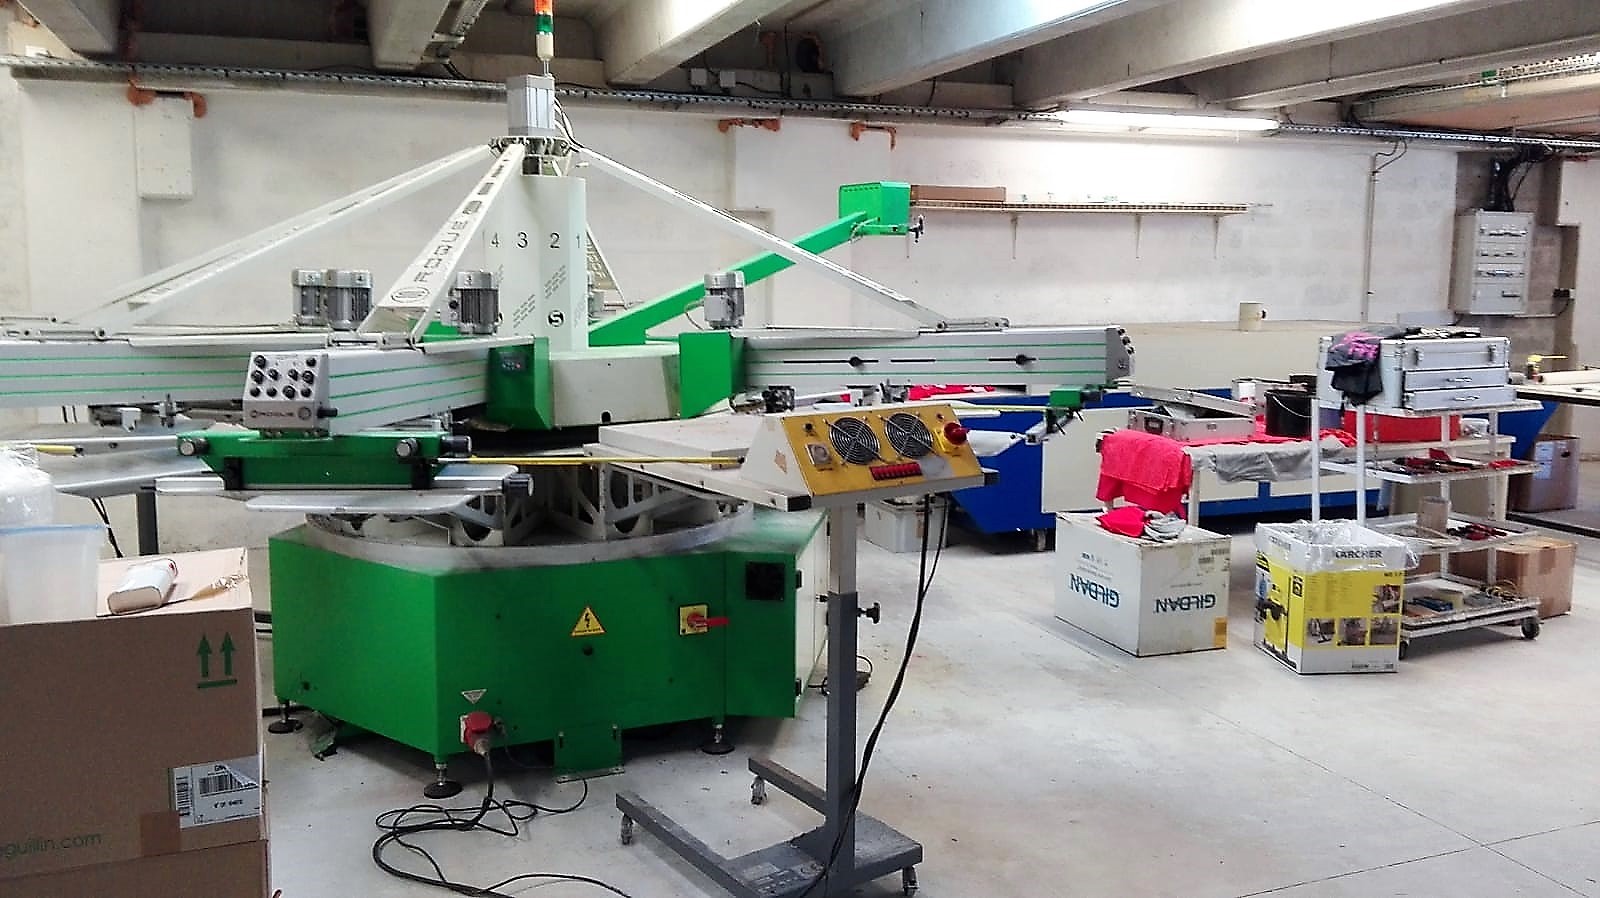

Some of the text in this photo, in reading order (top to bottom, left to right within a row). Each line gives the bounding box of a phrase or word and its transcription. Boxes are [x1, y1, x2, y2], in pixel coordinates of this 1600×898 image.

[491, 232, 500, 248] 4
[517, 231, 528, 248] 3
[550, 232, 560, 249] 2
[576, 234, 581, 249] 1
[413, 219, 468, 282] ROQUE
[1070, 572, 1120, 608] GILDAN
[1155, 594, 1216, 613] GILDAN
